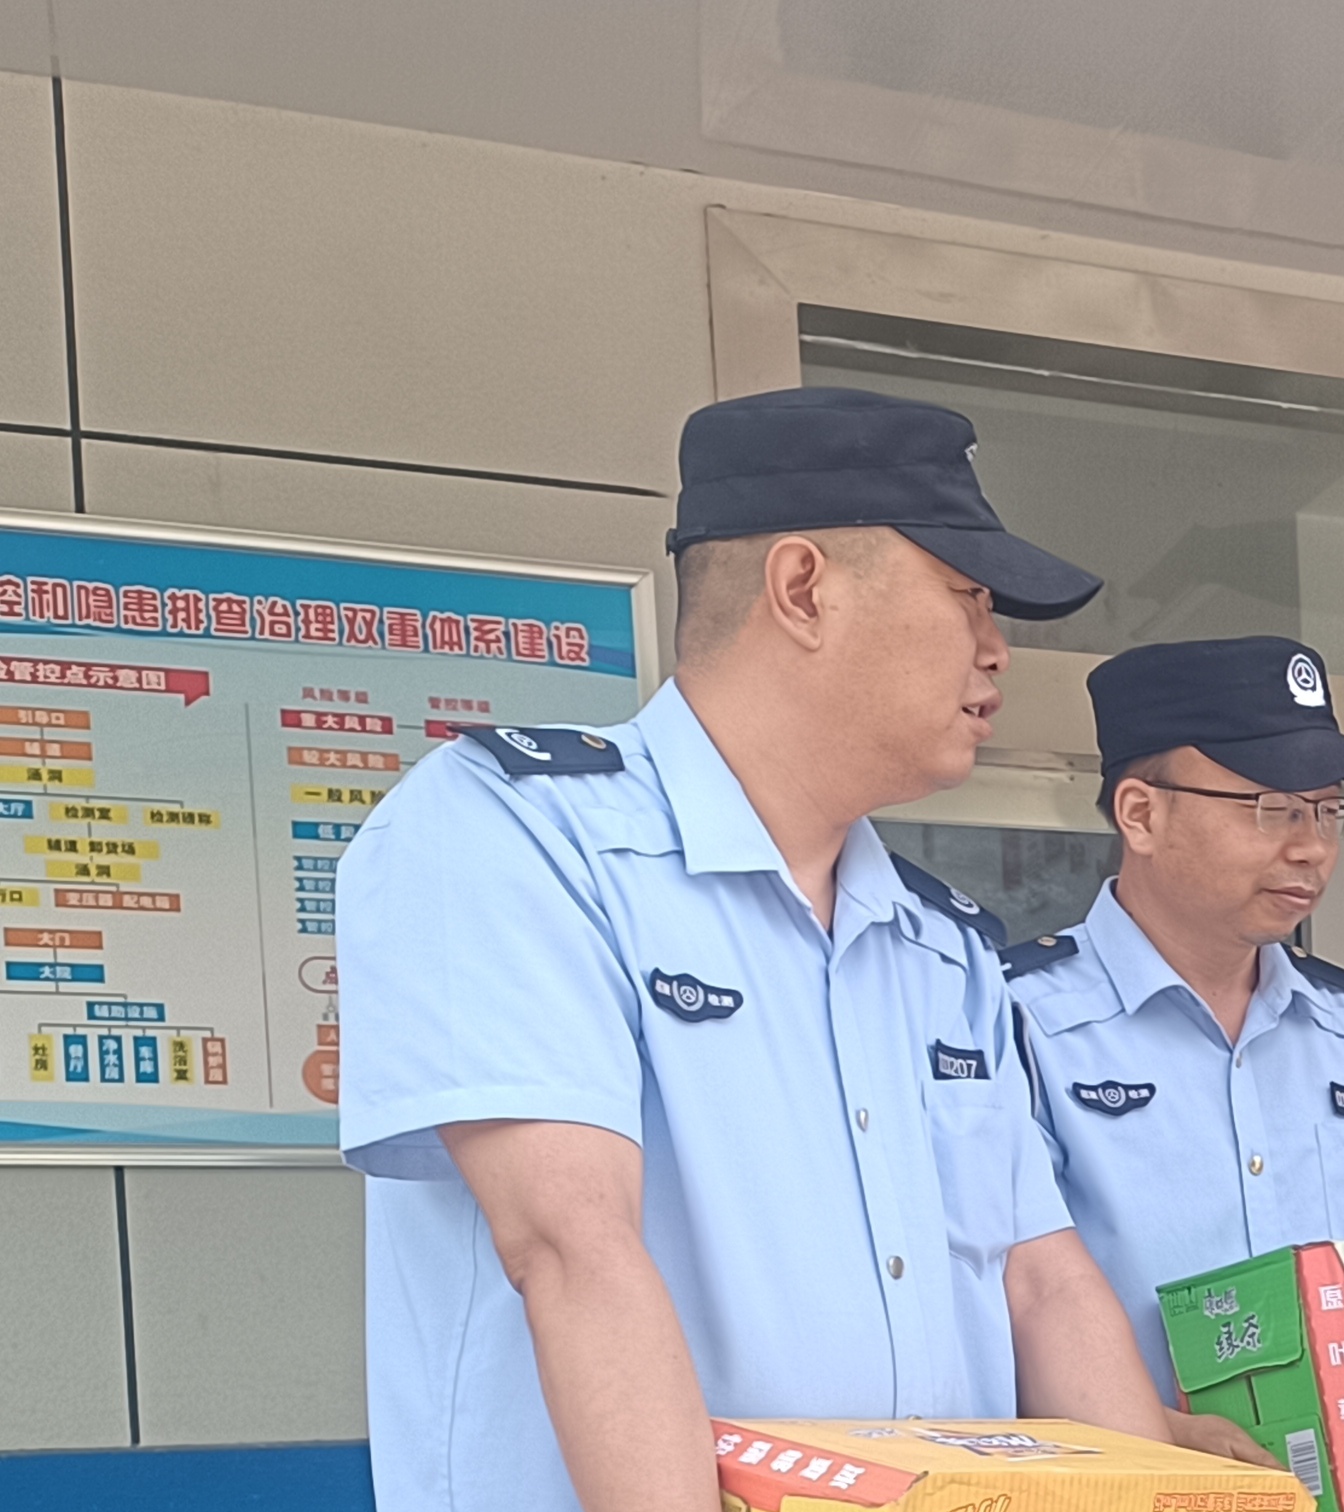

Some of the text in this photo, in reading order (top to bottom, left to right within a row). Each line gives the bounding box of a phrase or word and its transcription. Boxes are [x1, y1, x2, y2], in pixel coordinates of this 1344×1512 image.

[0, 574, 590, 666] 控和隐患排查治理双重体系建设
[300, 713, 383, 731] 重大风险
[302, 749, 385, 769] 较大风险
[65, 805, 112, 821] 检测室
[302, 858, 336, 872] 管控
[38, 932, 71, 946] 大门
[1215, 1312, 1262, 1362] 绿茶
